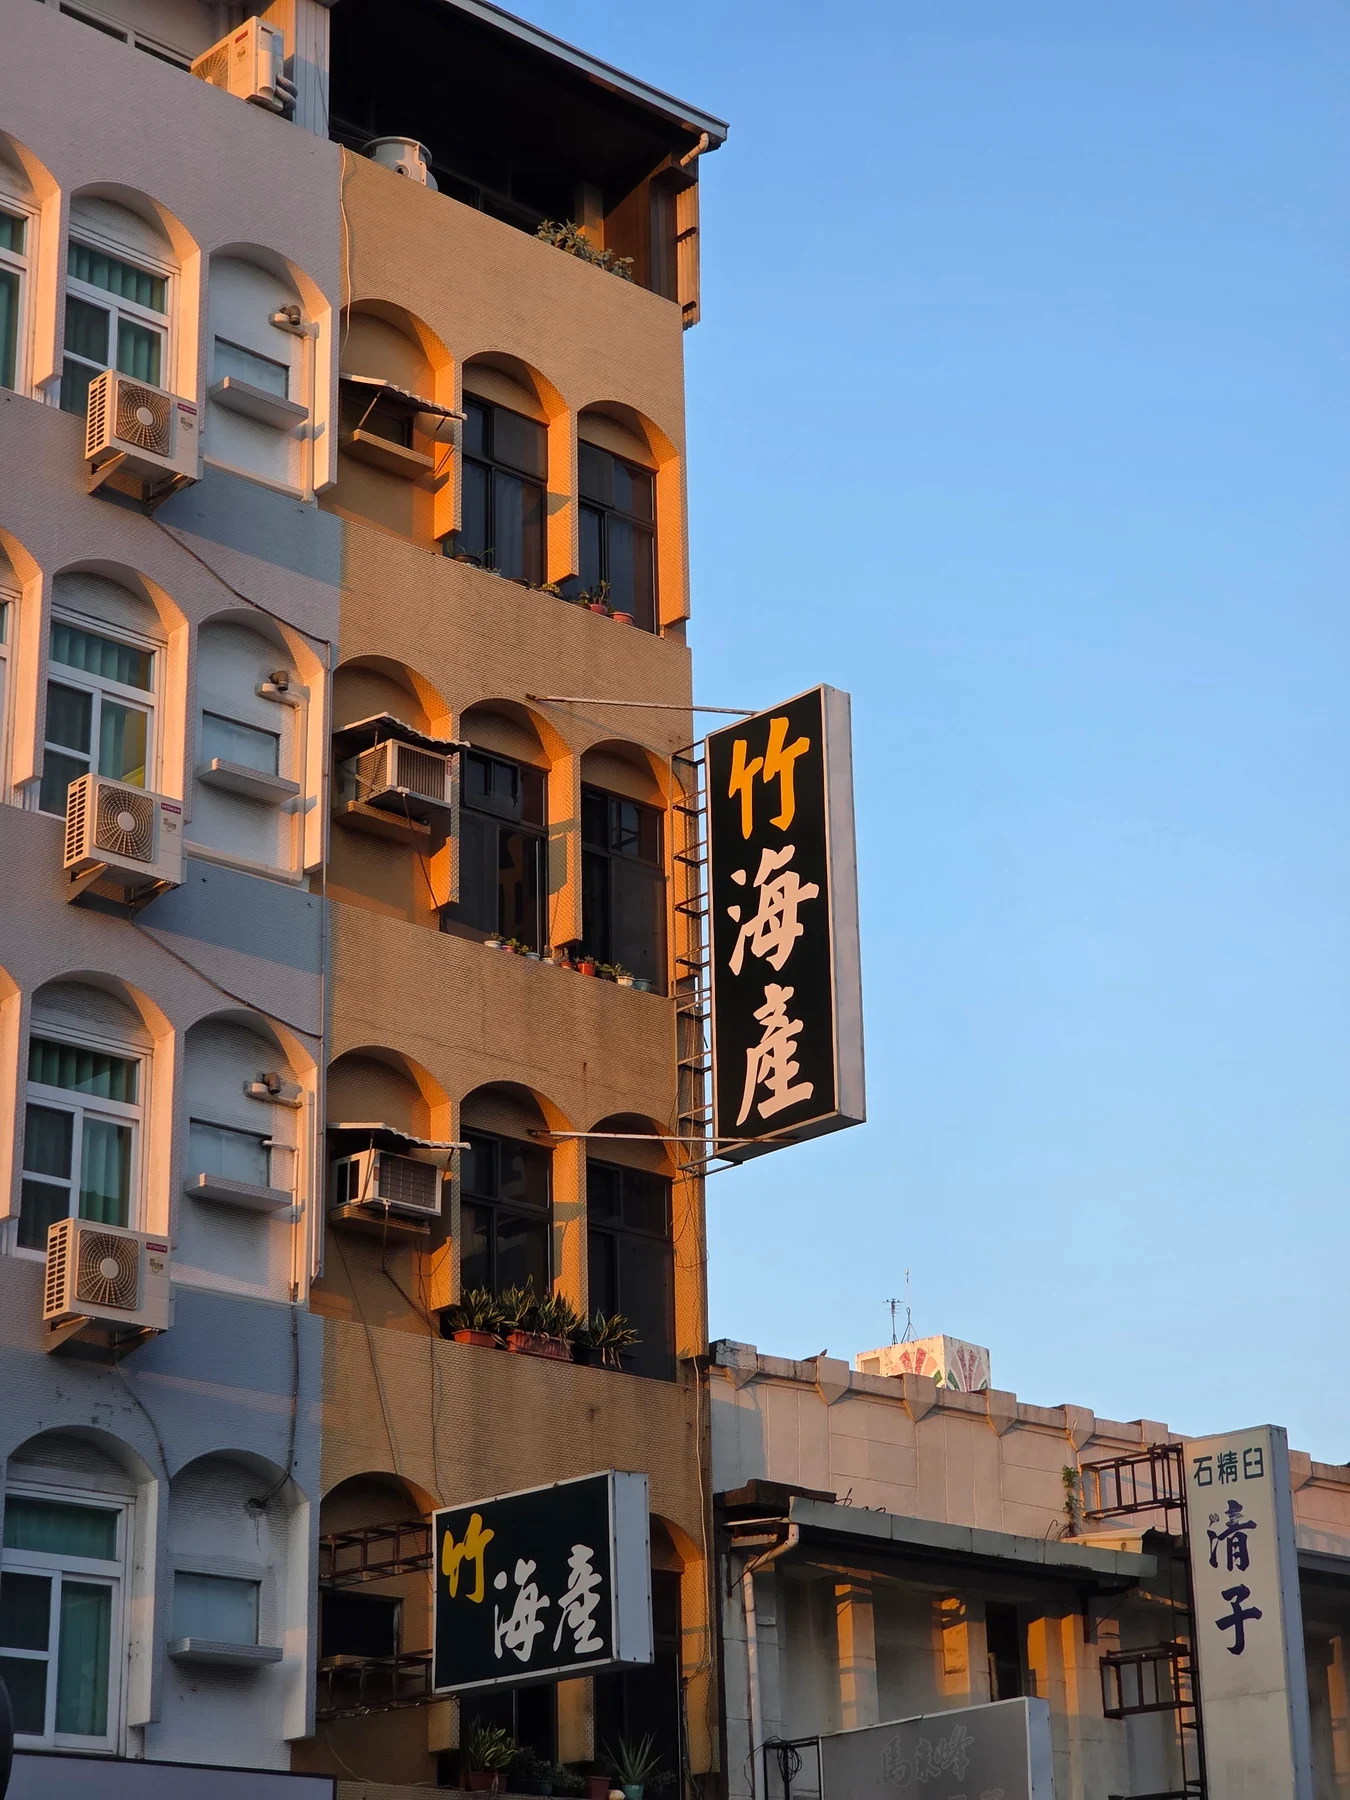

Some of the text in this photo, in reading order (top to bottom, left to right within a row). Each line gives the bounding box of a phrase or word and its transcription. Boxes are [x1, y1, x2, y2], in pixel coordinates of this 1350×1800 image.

[728, 717, 819, 1126] 竹海產
[147, 1243, 167, 1252] HITACHI
[1193, 1447, 1265, 1487] 石精臼
[442, 1513, 604, 1662] 竹海產
[1207, 1500, 1263, 1655] 清子
